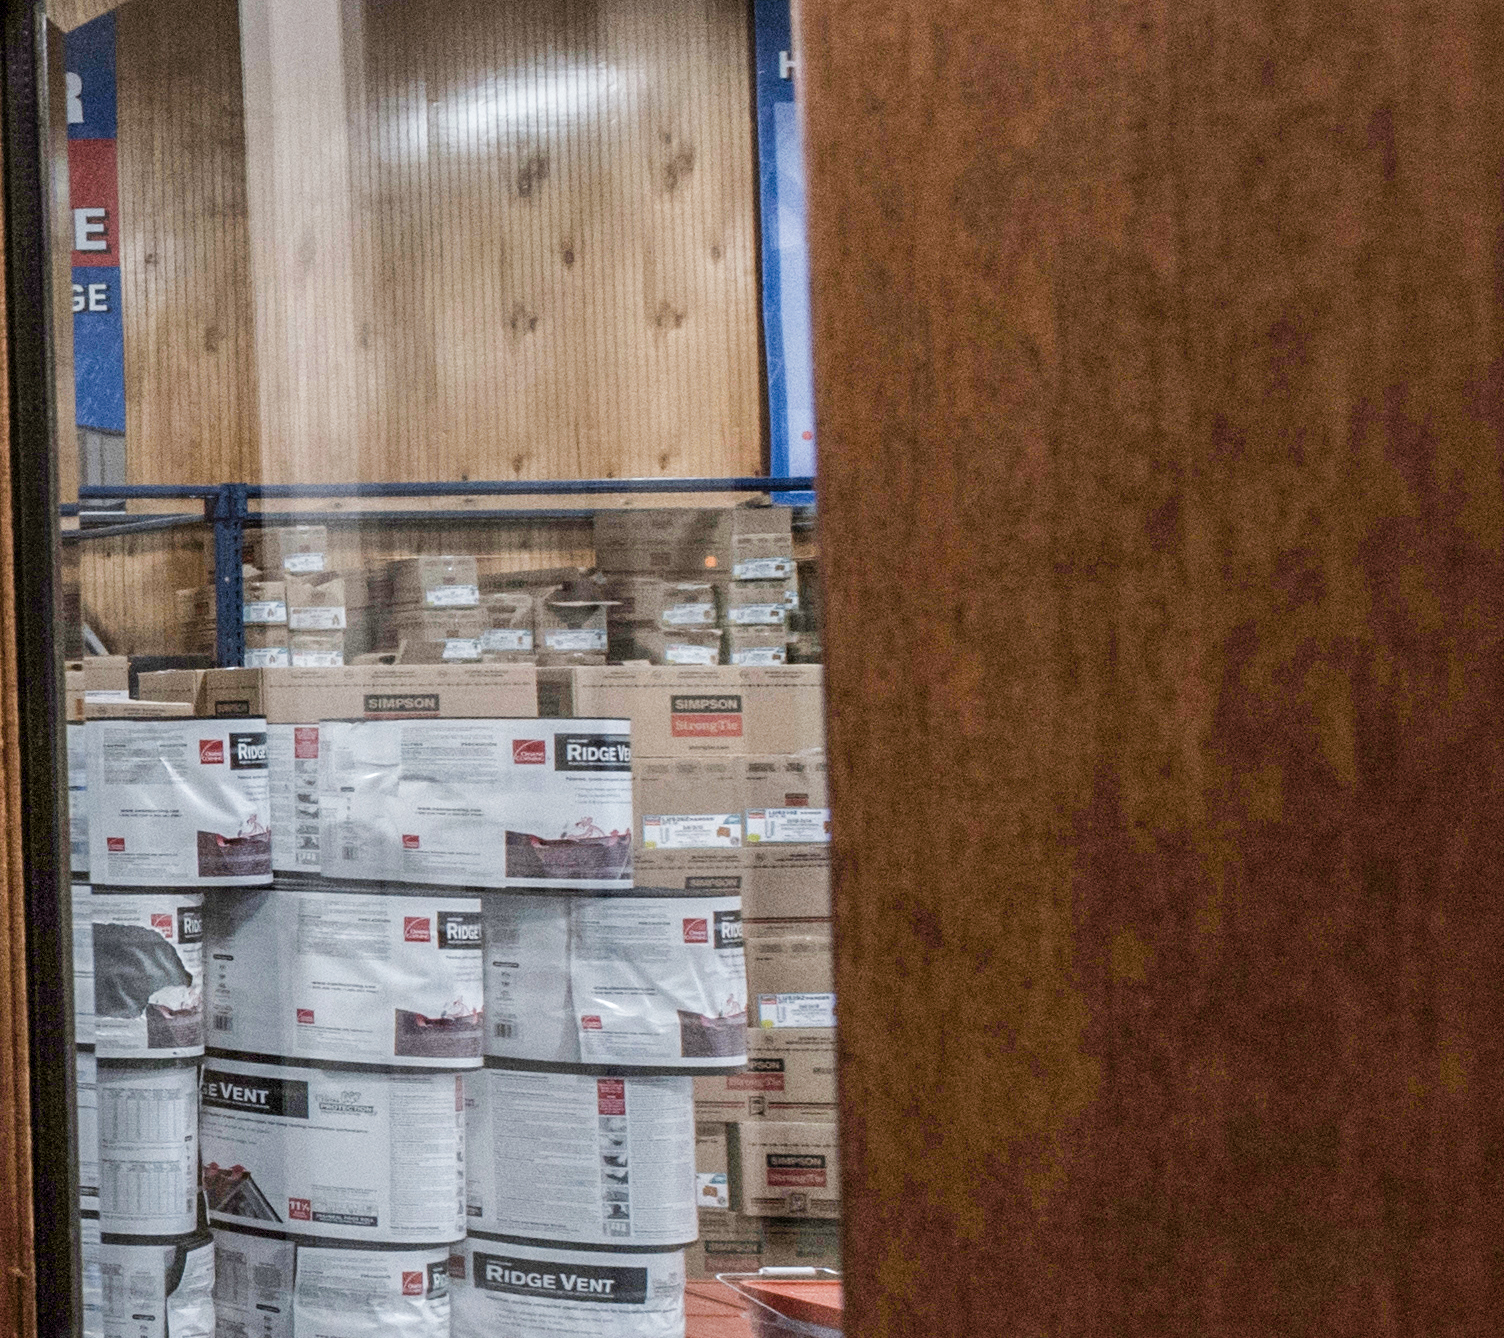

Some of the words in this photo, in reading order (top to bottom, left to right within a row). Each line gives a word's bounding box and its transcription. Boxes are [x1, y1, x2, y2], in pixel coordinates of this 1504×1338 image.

[368, 698, 435, 709] SIMPSON
[674, 698, 738, 710] SIMPSON
[566, 743, 617, 762] RIDGE
[446, 922, 479, 940] RIDGE
[220, 1081, 269, 1104] VENT
[487, 1264, 556, 1290] RIDGE
[560, 1273, 615, 1294] VENT
